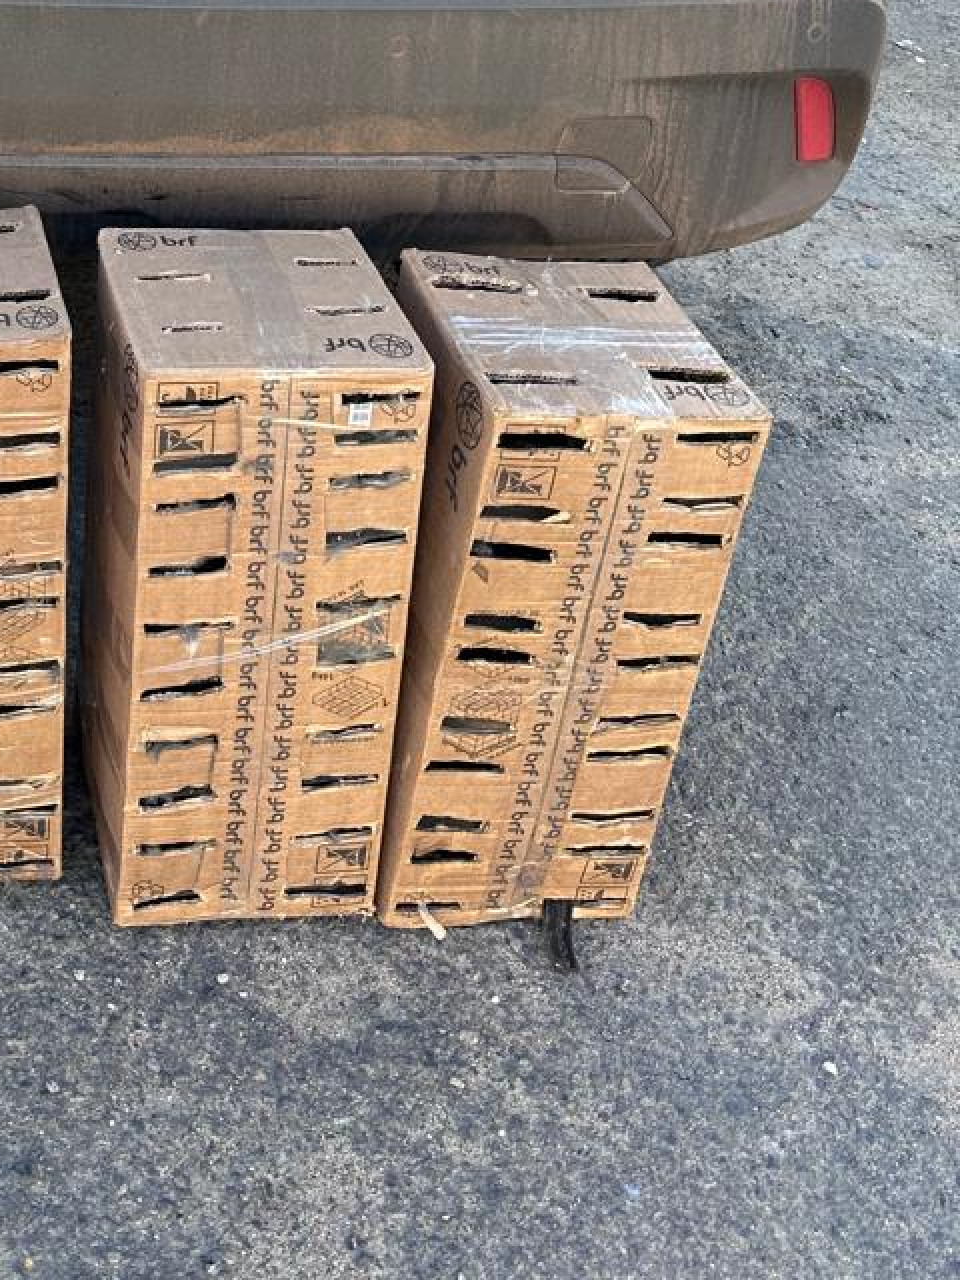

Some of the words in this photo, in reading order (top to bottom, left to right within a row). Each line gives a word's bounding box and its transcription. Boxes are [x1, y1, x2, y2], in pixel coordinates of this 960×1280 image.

[261, 380, 280, 410] brf
[299, 391, 320, 421] brf
[297, 428, 317, 458] brf
[639, 434, 662, 464] brf
[254, 455, 276, 484] brf
[293, 464, 314, 494] brf
[594, 463, 618, 490] brf
[630, 470, 654, 499] brf
[252, 490, 273, 519] brf
[290, 500, 312, 528] brf
[586, 497, 608, 524] brf
[622, 505, 646, 534] brf
[249, 526, 270, 555] brf
[576, 530, 599, 558] brf
[613, 540, 637, 568] brf
[246, 562, 267, 590] brf
[286, 570, 305, 600] brf
[568, 564, 591, 590] brf
[605, 574, 629, 600] brf
[244, 596, 264, 623] brf
[282, 605, 303, 632] brf
[559, 597, 582, 624] brf
[597, 606, 620, 632] brf
[552, 629, 574, 656] brf
[589, 638, 612, 662] brf
[239, 662, 259, 689] brf
[277, 672, 297, 698] brf
[237, 696, 256, 722] brf
[274, 703, 295, 730] brf
[537, 692, 559, 717] brf
[573, 698, 596, 724] brf
[234, 728, 254, 754] brf
[530, 722, 551, 746] brf
[272, 735, 292, 760] brf
[230, 758, 250, 784] brf
[522, 752, 544, 777] brf
[269, 766, 289, 792] brf
[228, 790, 248, 816] brf
[515, 782, 537, 806] brf
[266, 798, 286, 824] brf
[507, 812, 528, 835] brf
[226, 820, 245, 845] brf
[263, 828, 283, 854] brf
[223, 850, 242, 873] brf
[500, 840, 522, 860] brf
[260, 858, 280, 882] brf
[257, 887, 276, 910] brf
